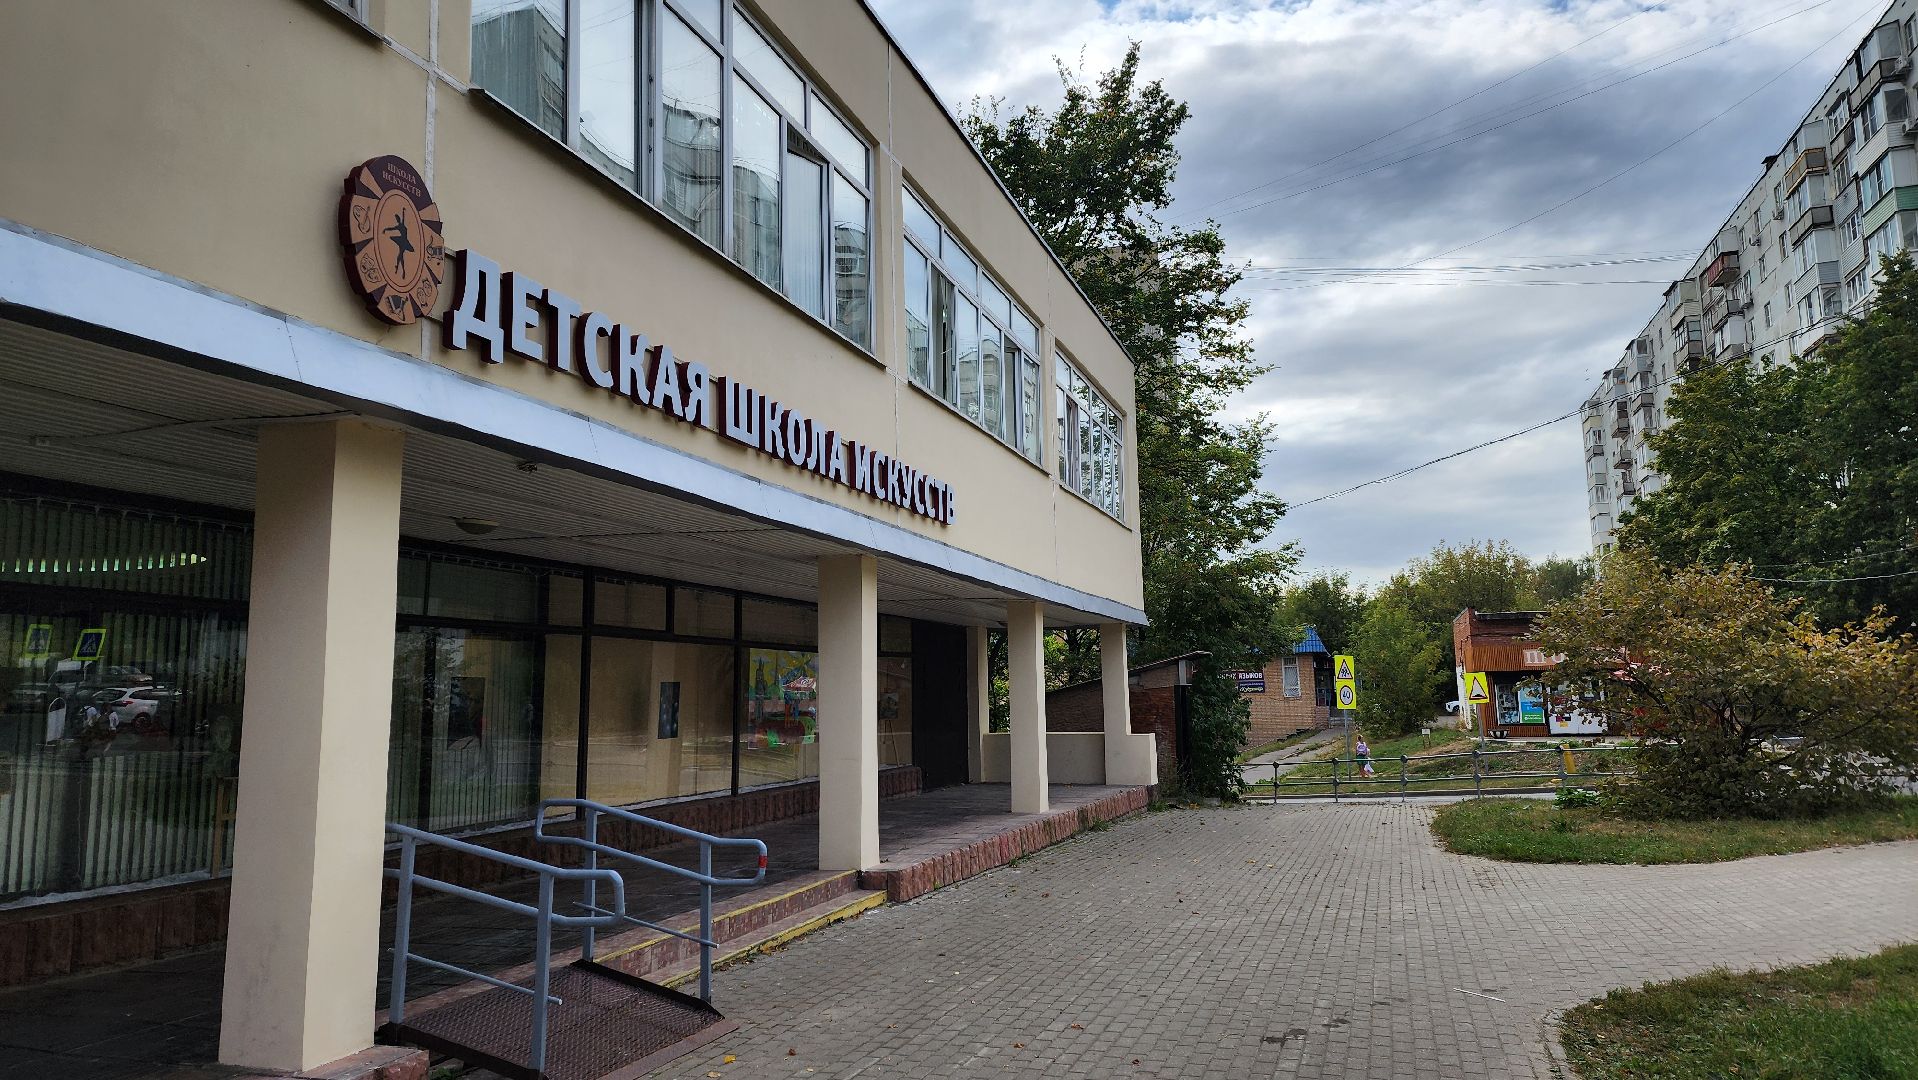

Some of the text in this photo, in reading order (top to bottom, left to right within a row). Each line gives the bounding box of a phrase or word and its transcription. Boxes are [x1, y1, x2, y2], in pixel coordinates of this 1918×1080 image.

[382, 170, 421, 197] ИСКУССТВ
[387, 162, 417, 185] ШКОЛА
[447, 248, 957, 526] ДЕТСКАЯ ШКОЛА ИСКУССТВ
